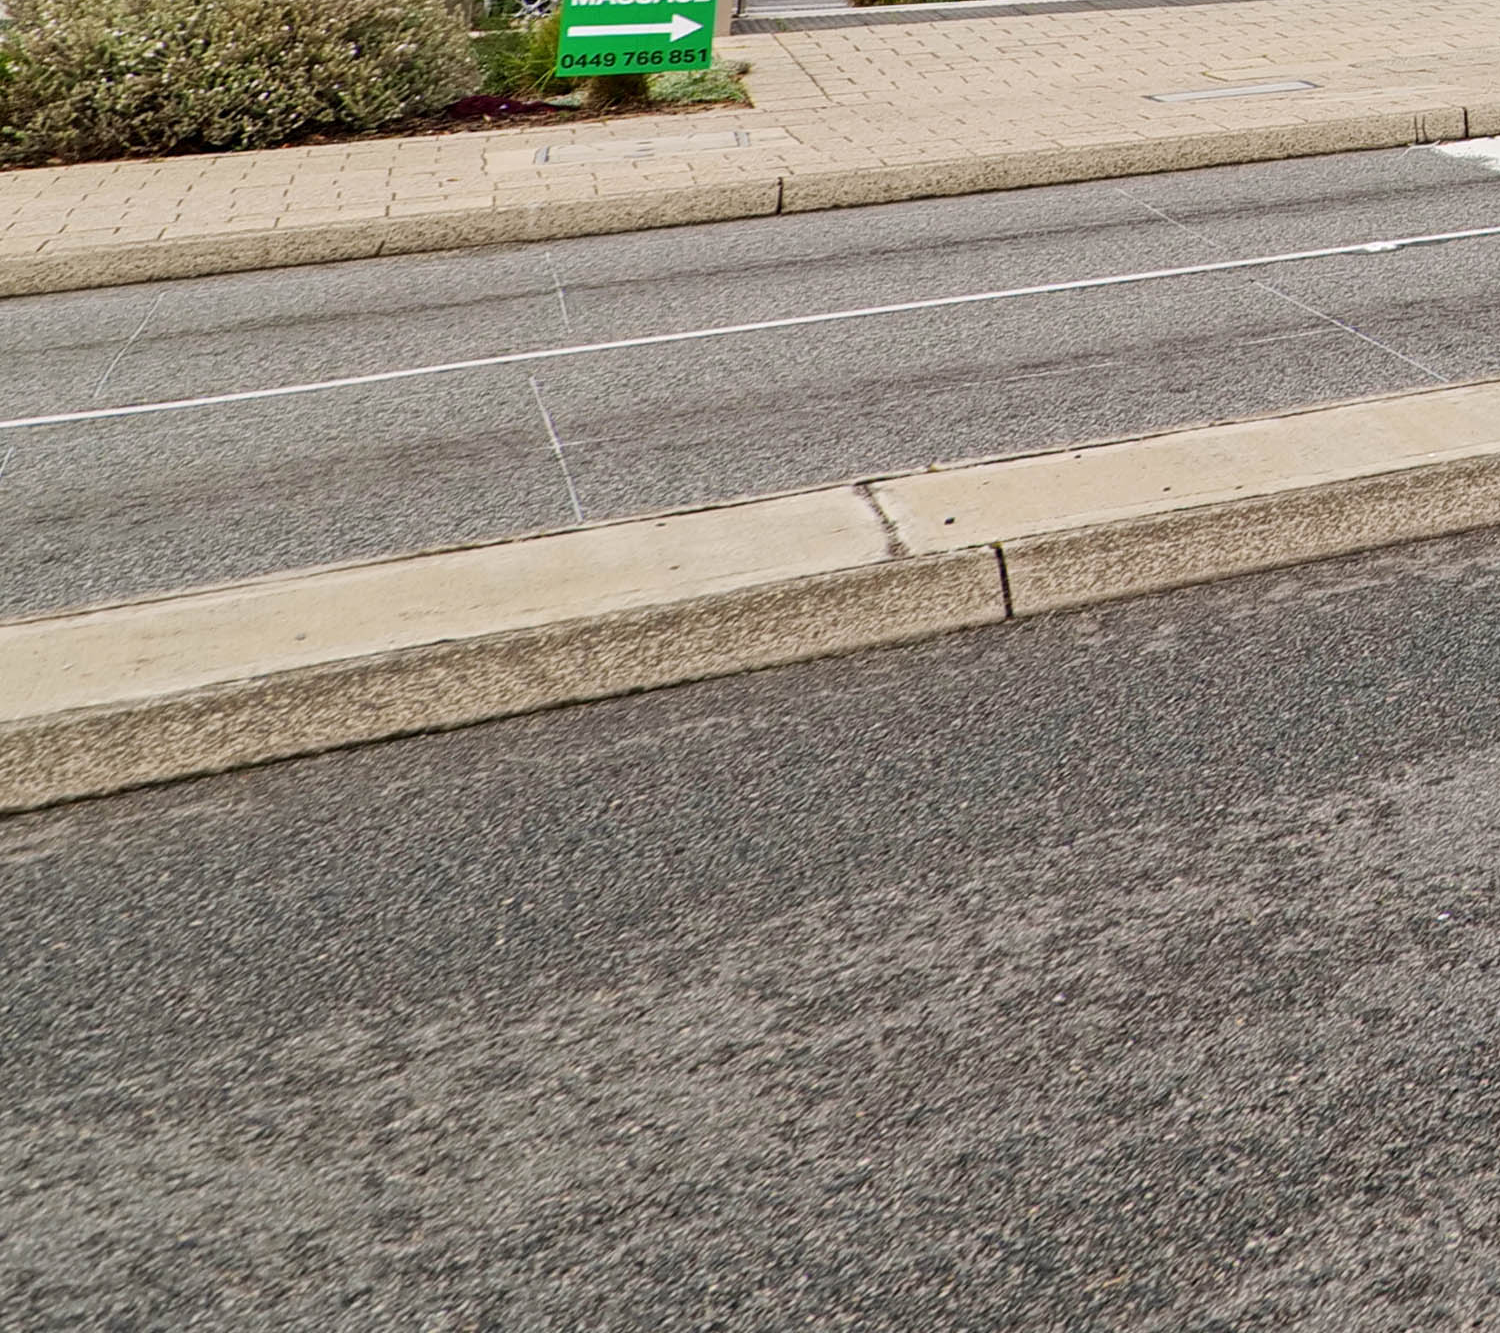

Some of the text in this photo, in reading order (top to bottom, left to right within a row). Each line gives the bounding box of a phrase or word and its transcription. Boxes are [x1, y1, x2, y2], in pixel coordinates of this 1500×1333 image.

[560, 48, 708, 69] 0449 766 851
